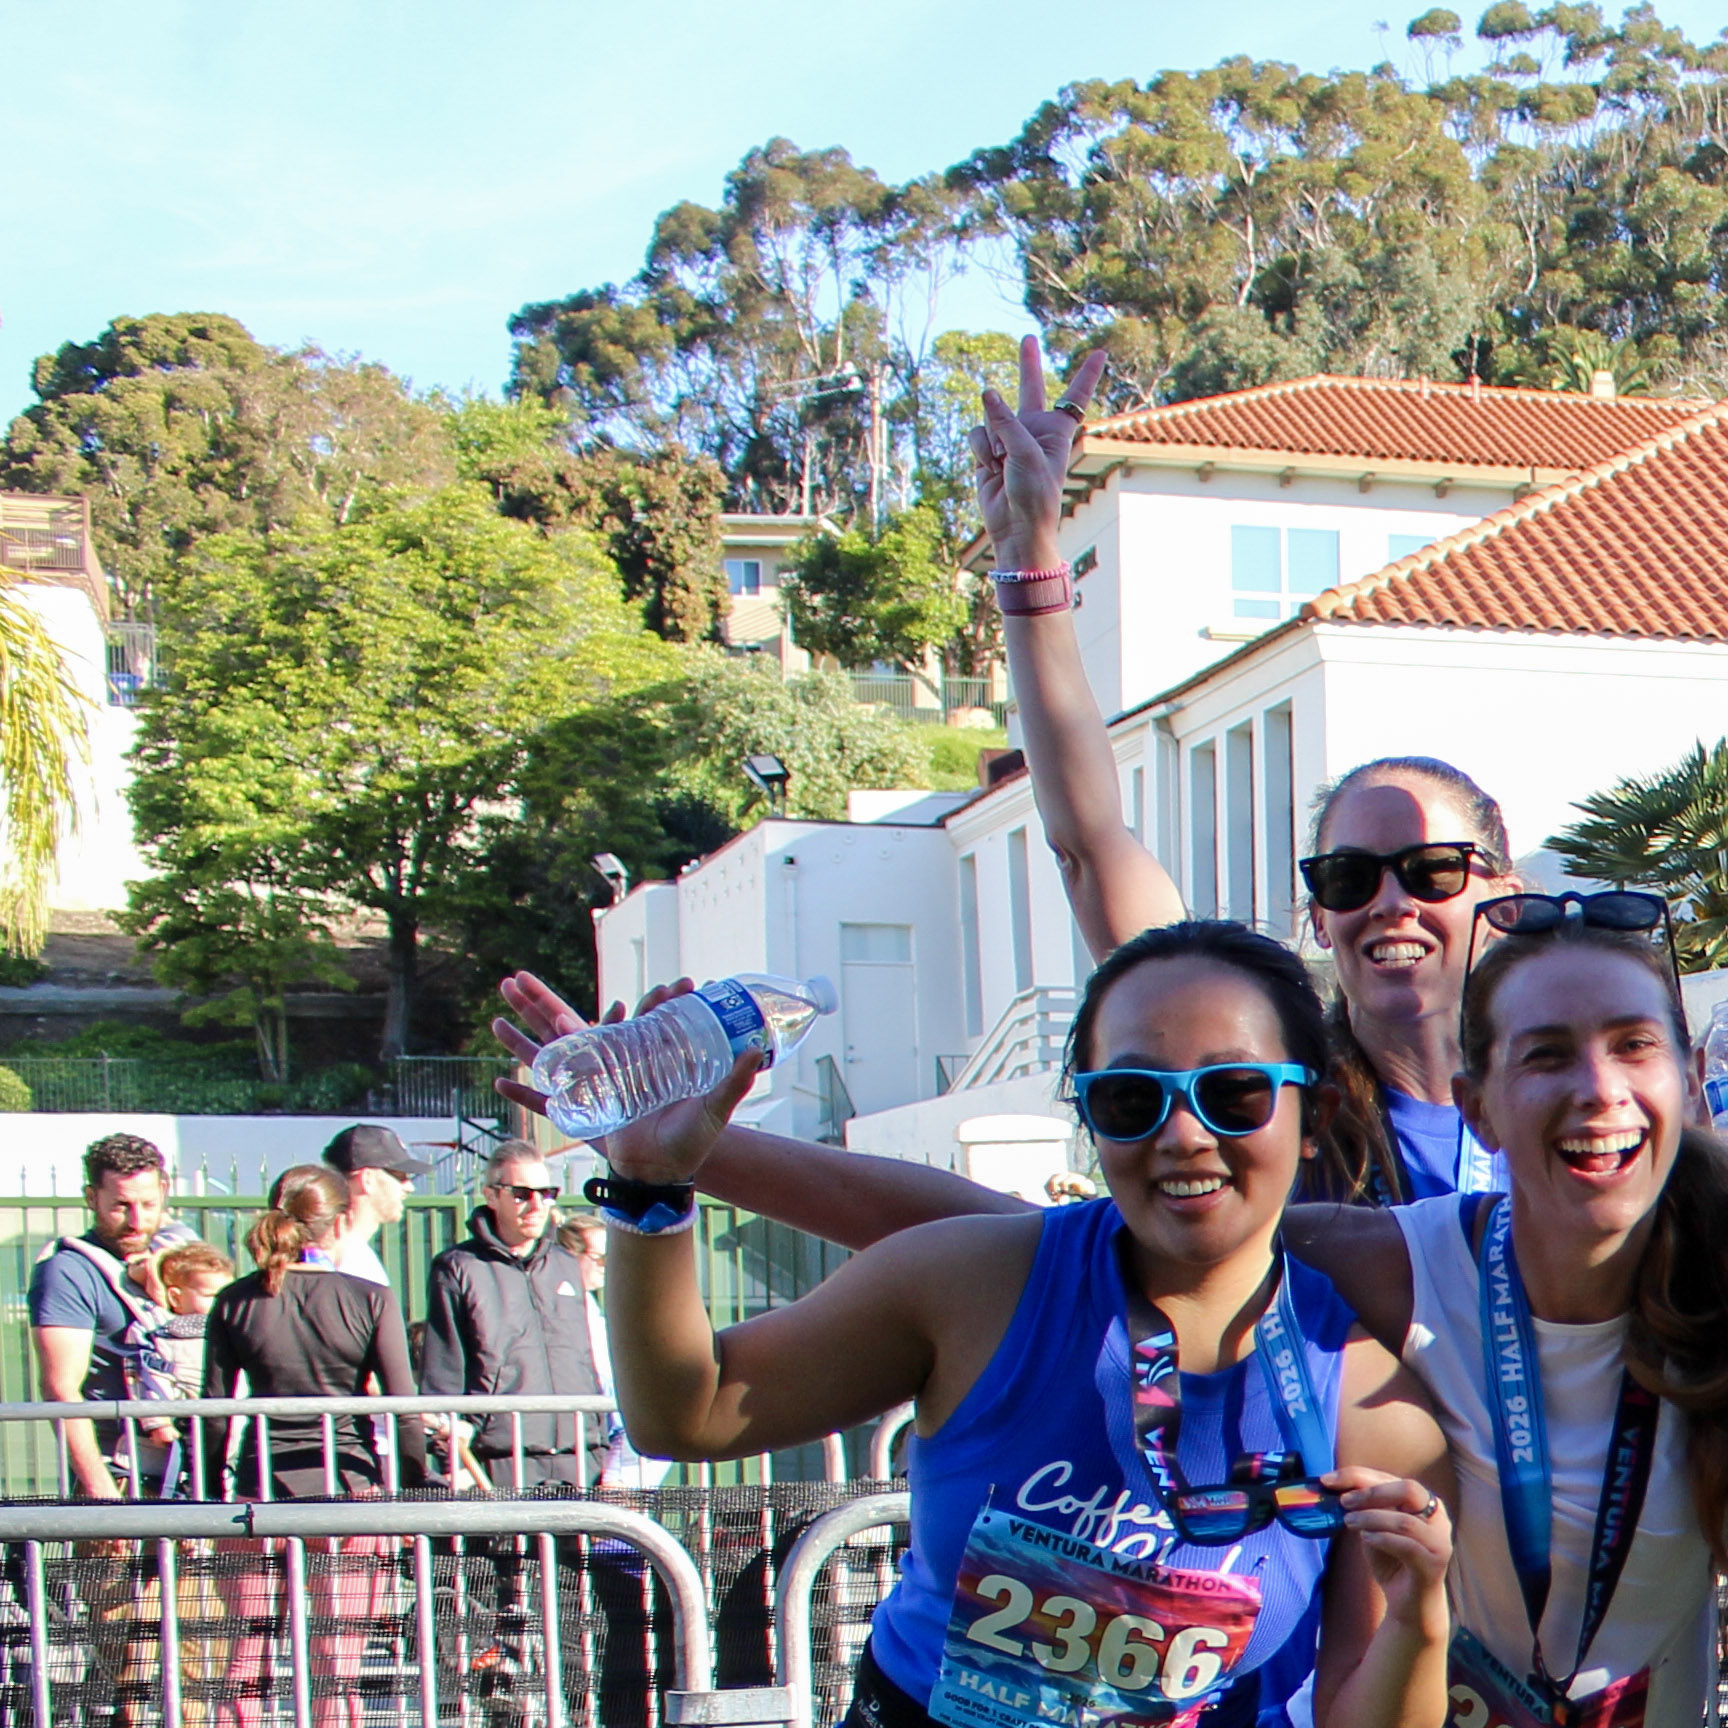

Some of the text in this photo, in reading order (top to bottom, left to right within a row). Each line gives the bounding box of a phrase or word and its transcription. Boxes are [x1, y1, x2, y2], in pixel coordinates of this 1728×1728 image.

[1487, 1190, 1534, 1465] 2026 HALF MARATH
[1275, 1347, 1308, 1418] 2026
[1596, 1426, 1641, 1571] VENTURA
[1008, 1518, 1105, 1568] VENTURA
[1109, 1556, 1232, 1593] MARATHON
[966, 1573, 1231, 1700] 2366
[958, 1669, 1031, 1710] HALF
